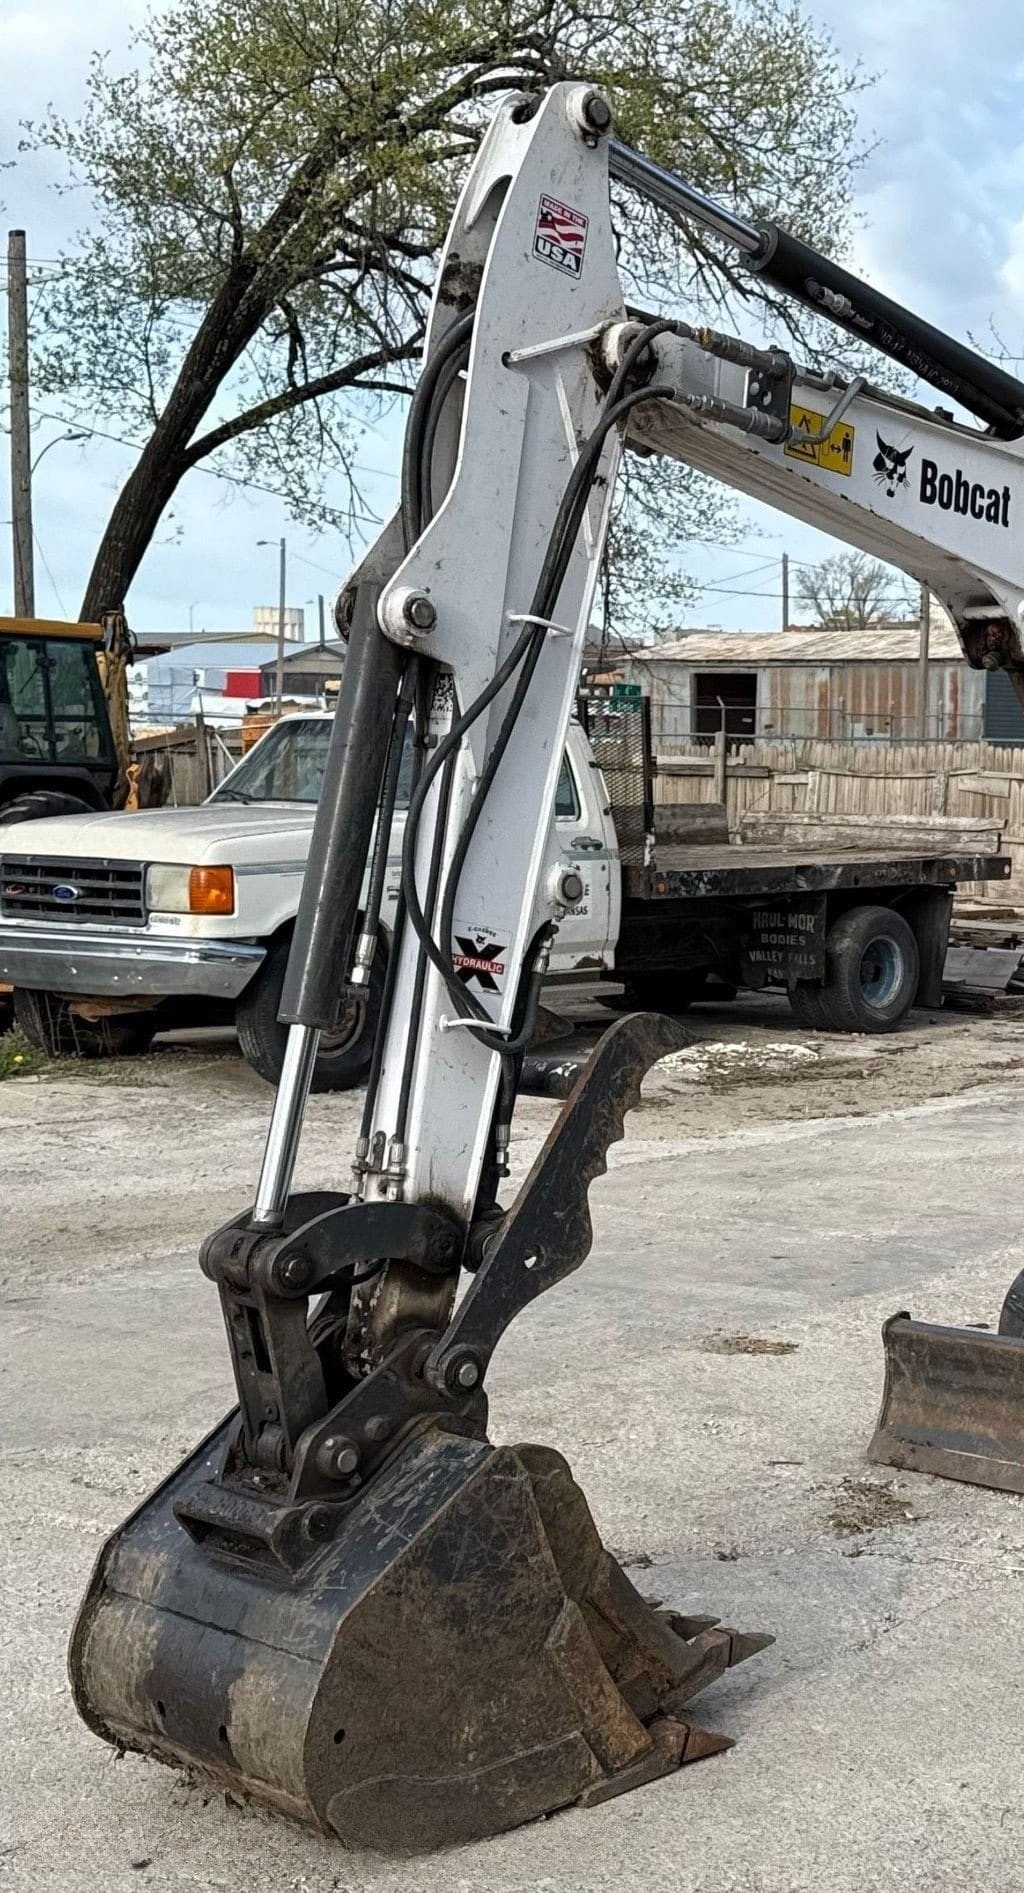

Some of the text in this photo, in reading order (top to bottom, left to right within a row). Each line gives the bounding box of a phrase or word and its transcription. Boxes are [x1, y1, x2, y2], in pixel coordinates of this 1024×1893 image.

[537, 236, 577, 272] USA
[920, 458, 1011, 528] Bobcat
[760, 933, 806, 946] BODIES
[748, 950, 784, 962] VALLEY
